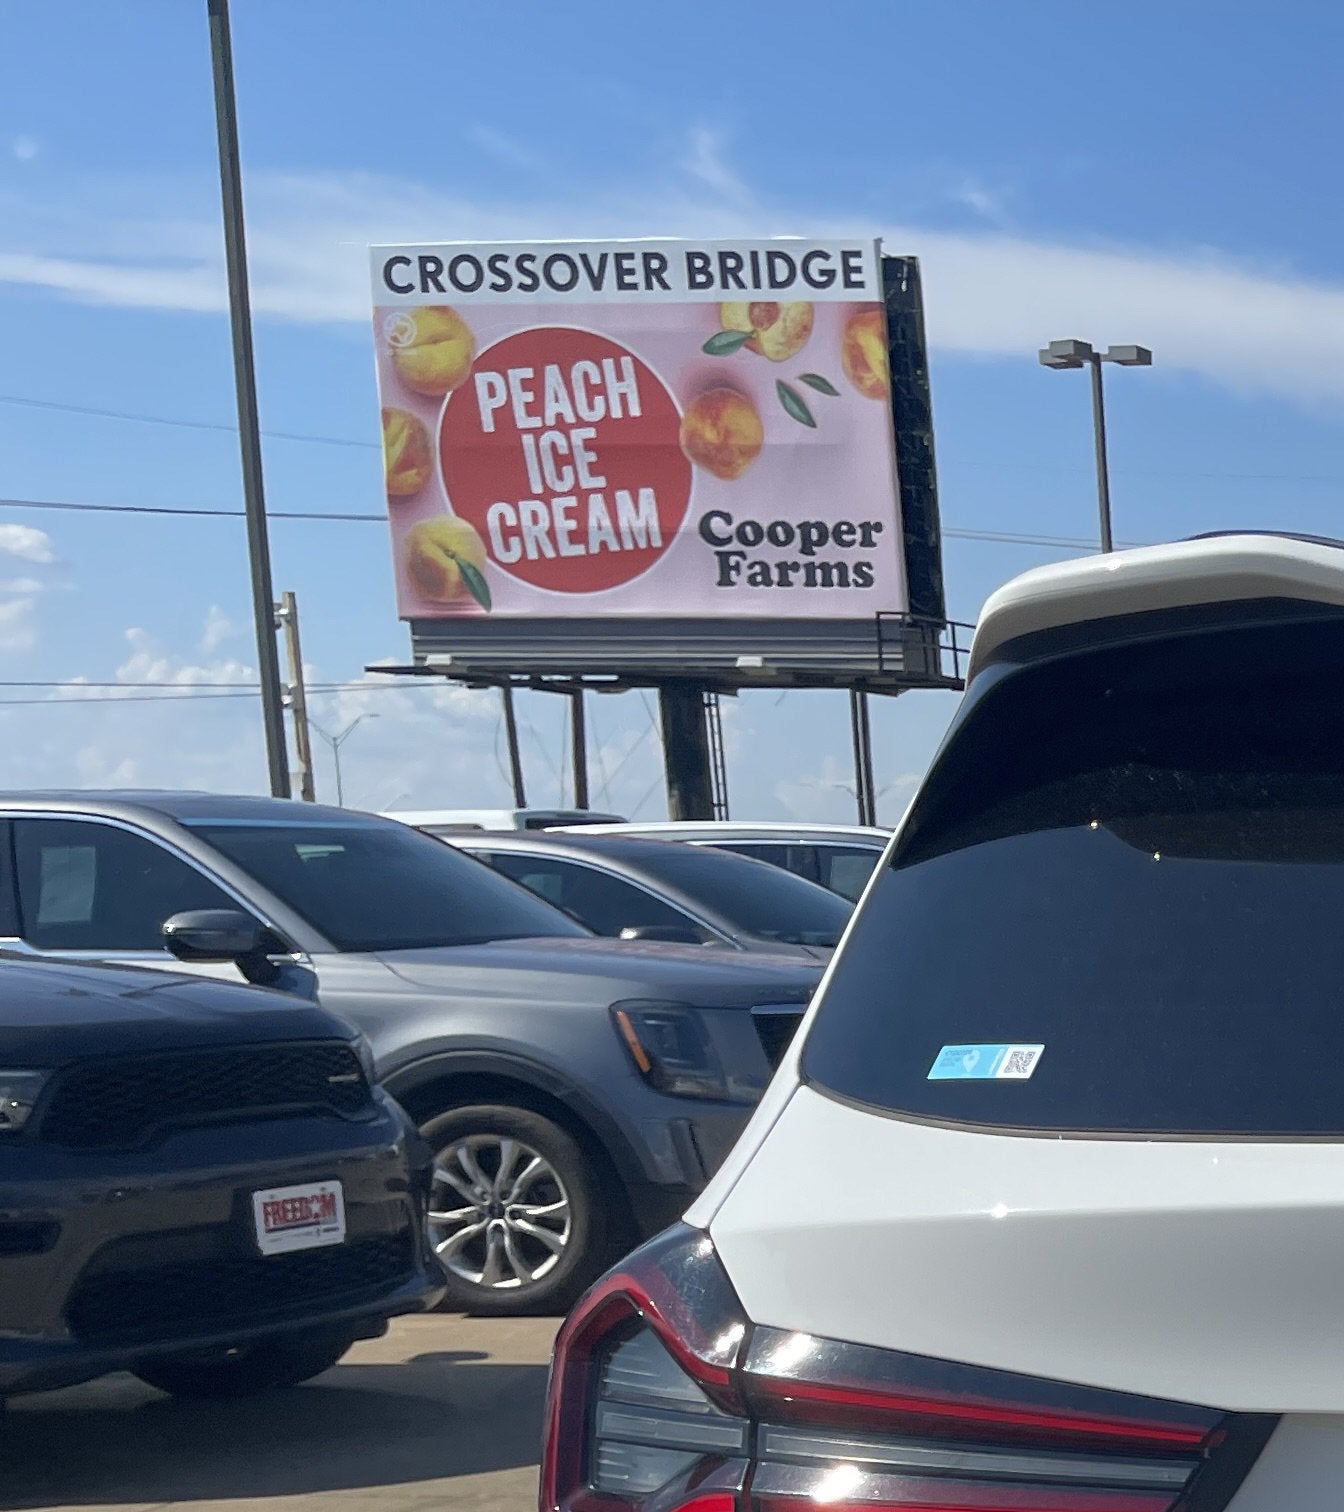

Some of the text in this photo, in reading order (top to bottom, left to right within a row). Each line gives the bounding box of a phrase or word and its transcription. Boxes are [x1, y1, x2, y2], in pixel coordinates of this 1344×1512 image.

[382, 249, 866, 294] CROSSOVER BRIDGE
[474, 356, 643, 433] PEACH
[521, 427, 607, 494] ICE
[485, 487, 663, 565] CREAM
[698, 510, 884, 555] Cooper
[714, 550, 875, 588] Farms
